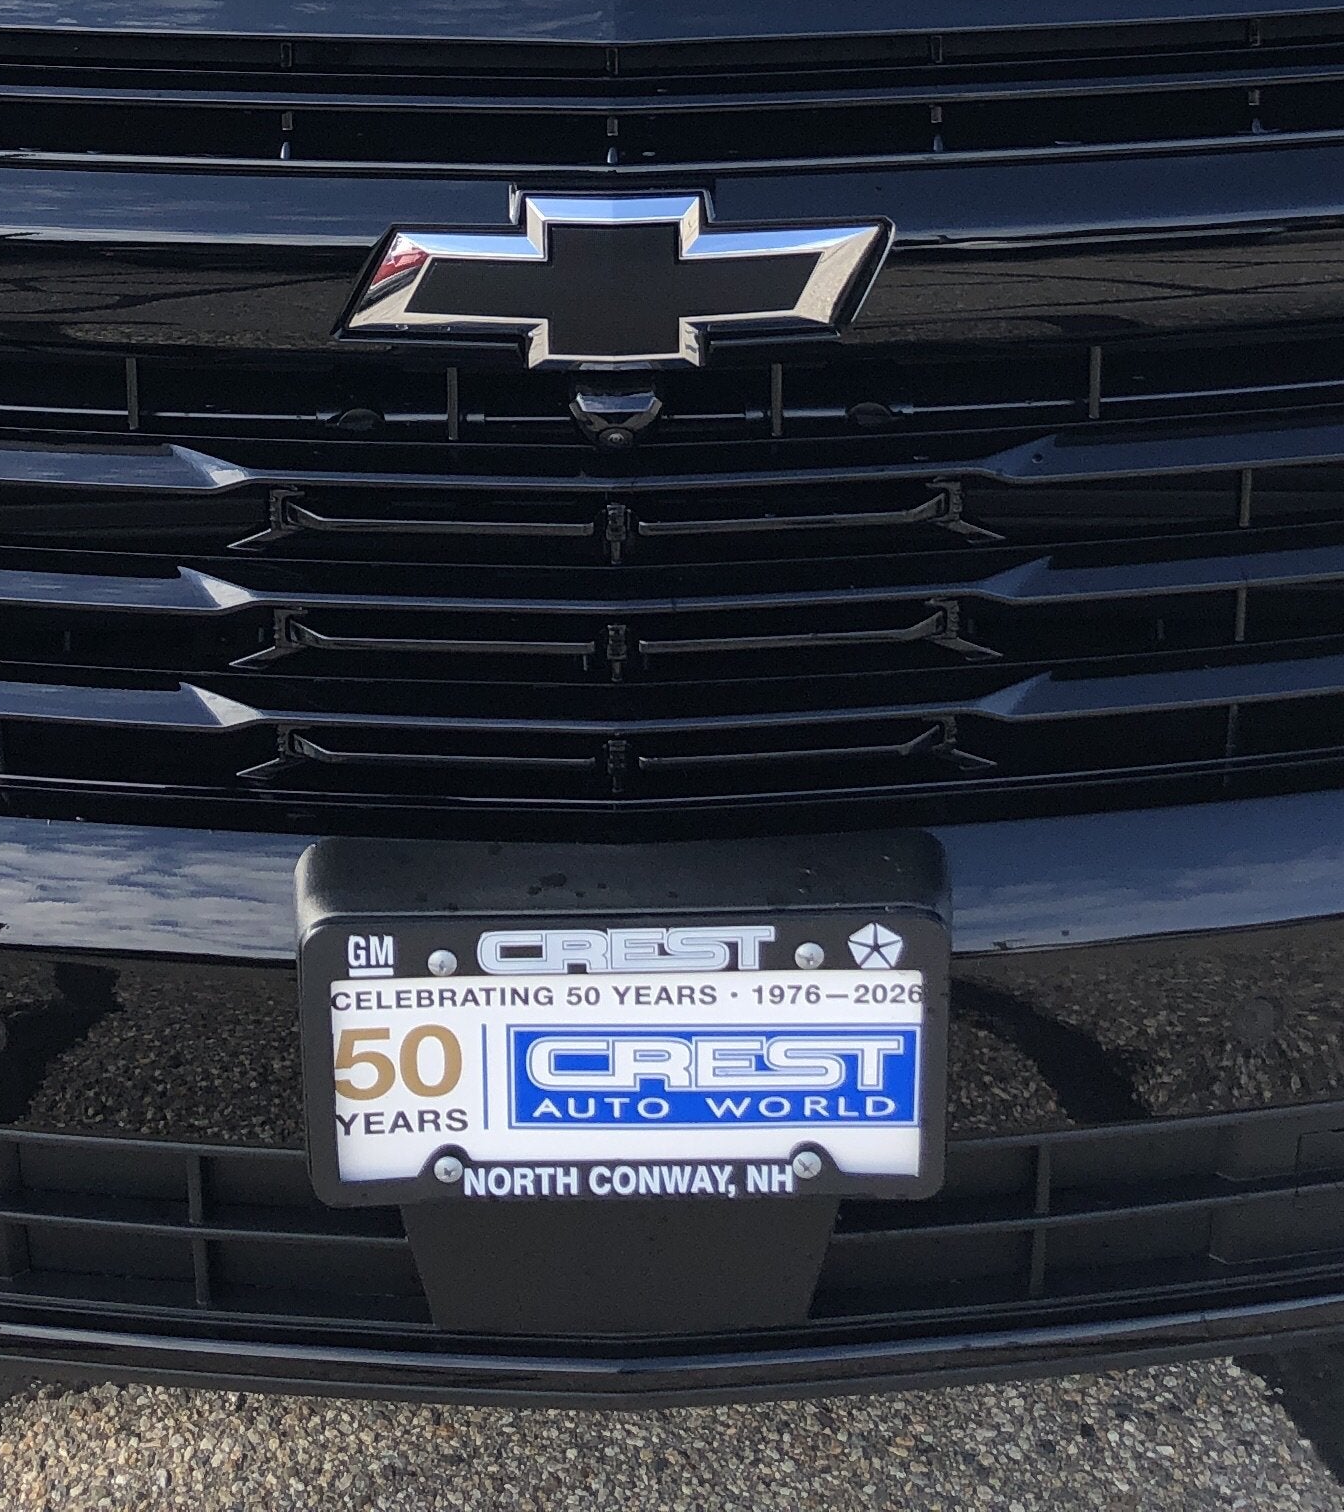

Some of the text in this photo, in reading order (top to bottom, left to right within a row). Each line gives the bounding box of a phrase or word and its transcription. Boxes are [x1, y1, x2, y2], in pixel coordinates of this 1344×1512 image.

[347, 934, 394, 967] GM
[477, 925, 776, 975] CREST
[331, 986, 554, 1011] CELEBRATING
[566, 986, 601, 1007] 50
[614, 984, 718, 1006] YEARS
[335, 1023, 463, 1101] 50
[525, 1035, 904, 1093] CREST
[335, 1108, 469, 1136] YEARS
[532, 1095, 897, 1119] AUTO WORLD
[463, 1164, 794, 1199] NORTH CONWAY, NH
